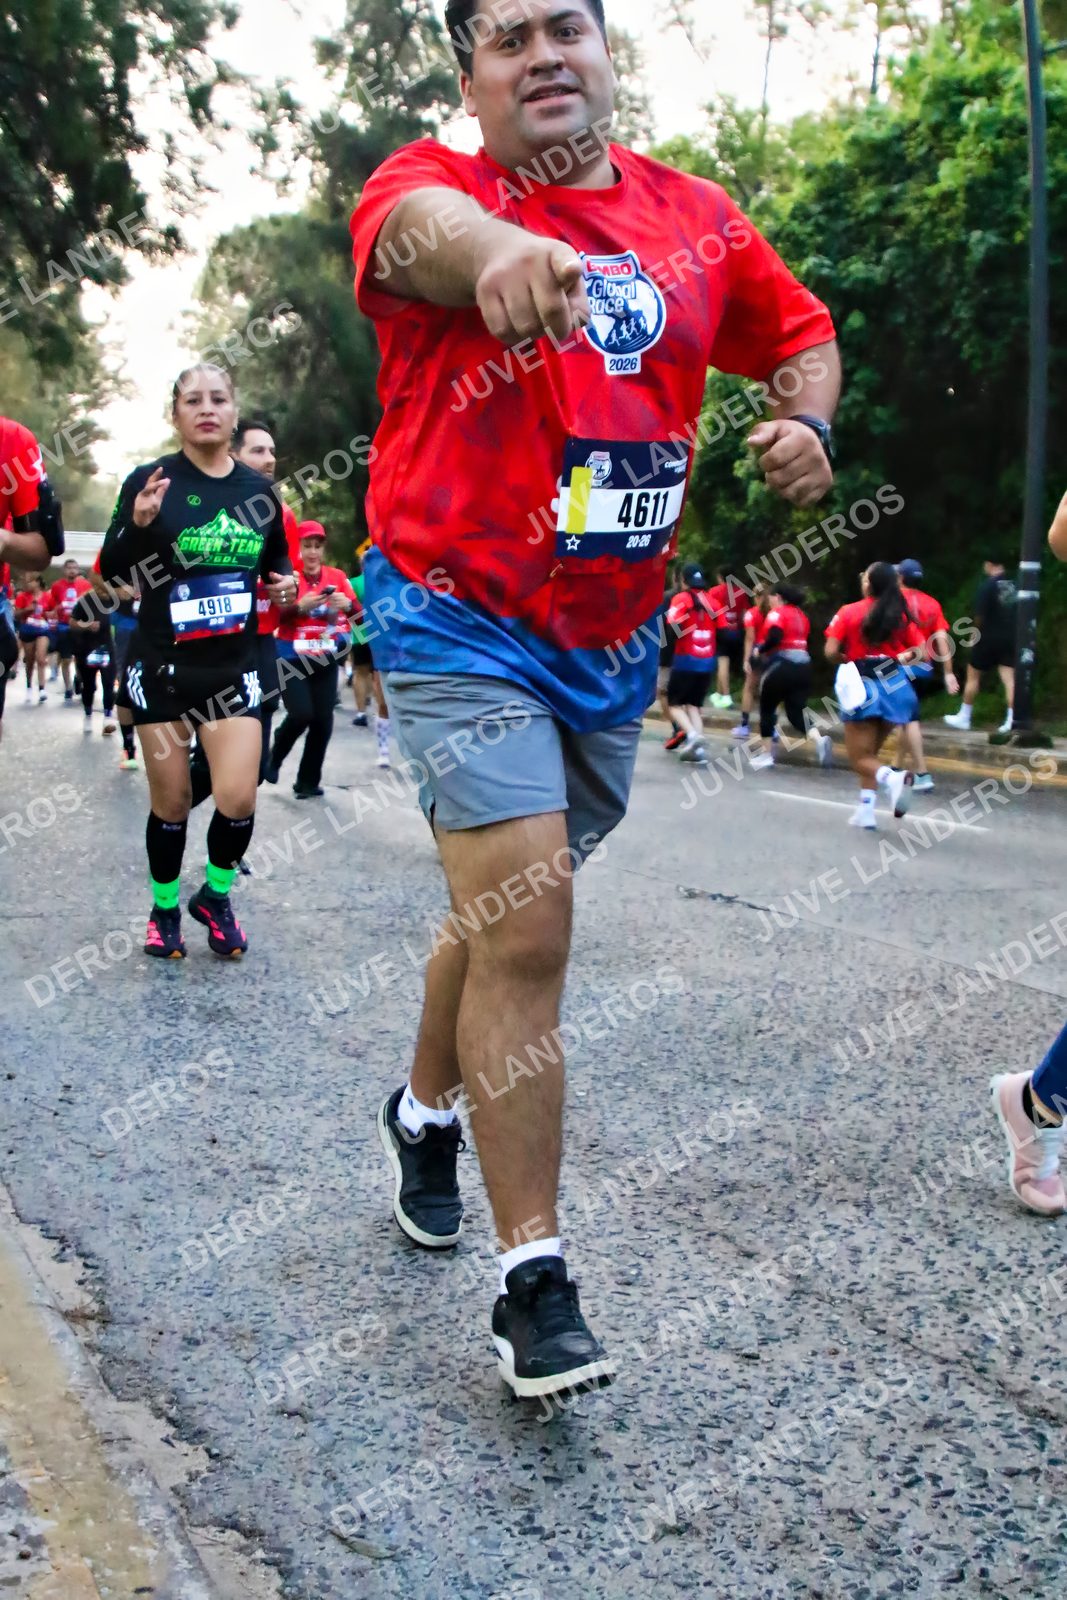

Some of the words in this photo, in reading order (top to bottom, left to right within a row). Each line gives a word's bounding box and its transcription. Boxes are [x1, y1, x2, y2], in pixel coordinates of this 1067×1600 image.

[609, 357, 638, 371] 2026
[617, 491, 669, 528] 4611
[181, 536, 223, 551] GREEN
[230, 538, 262, 554] TEAM
[198, 596, 232, 616] 4918
